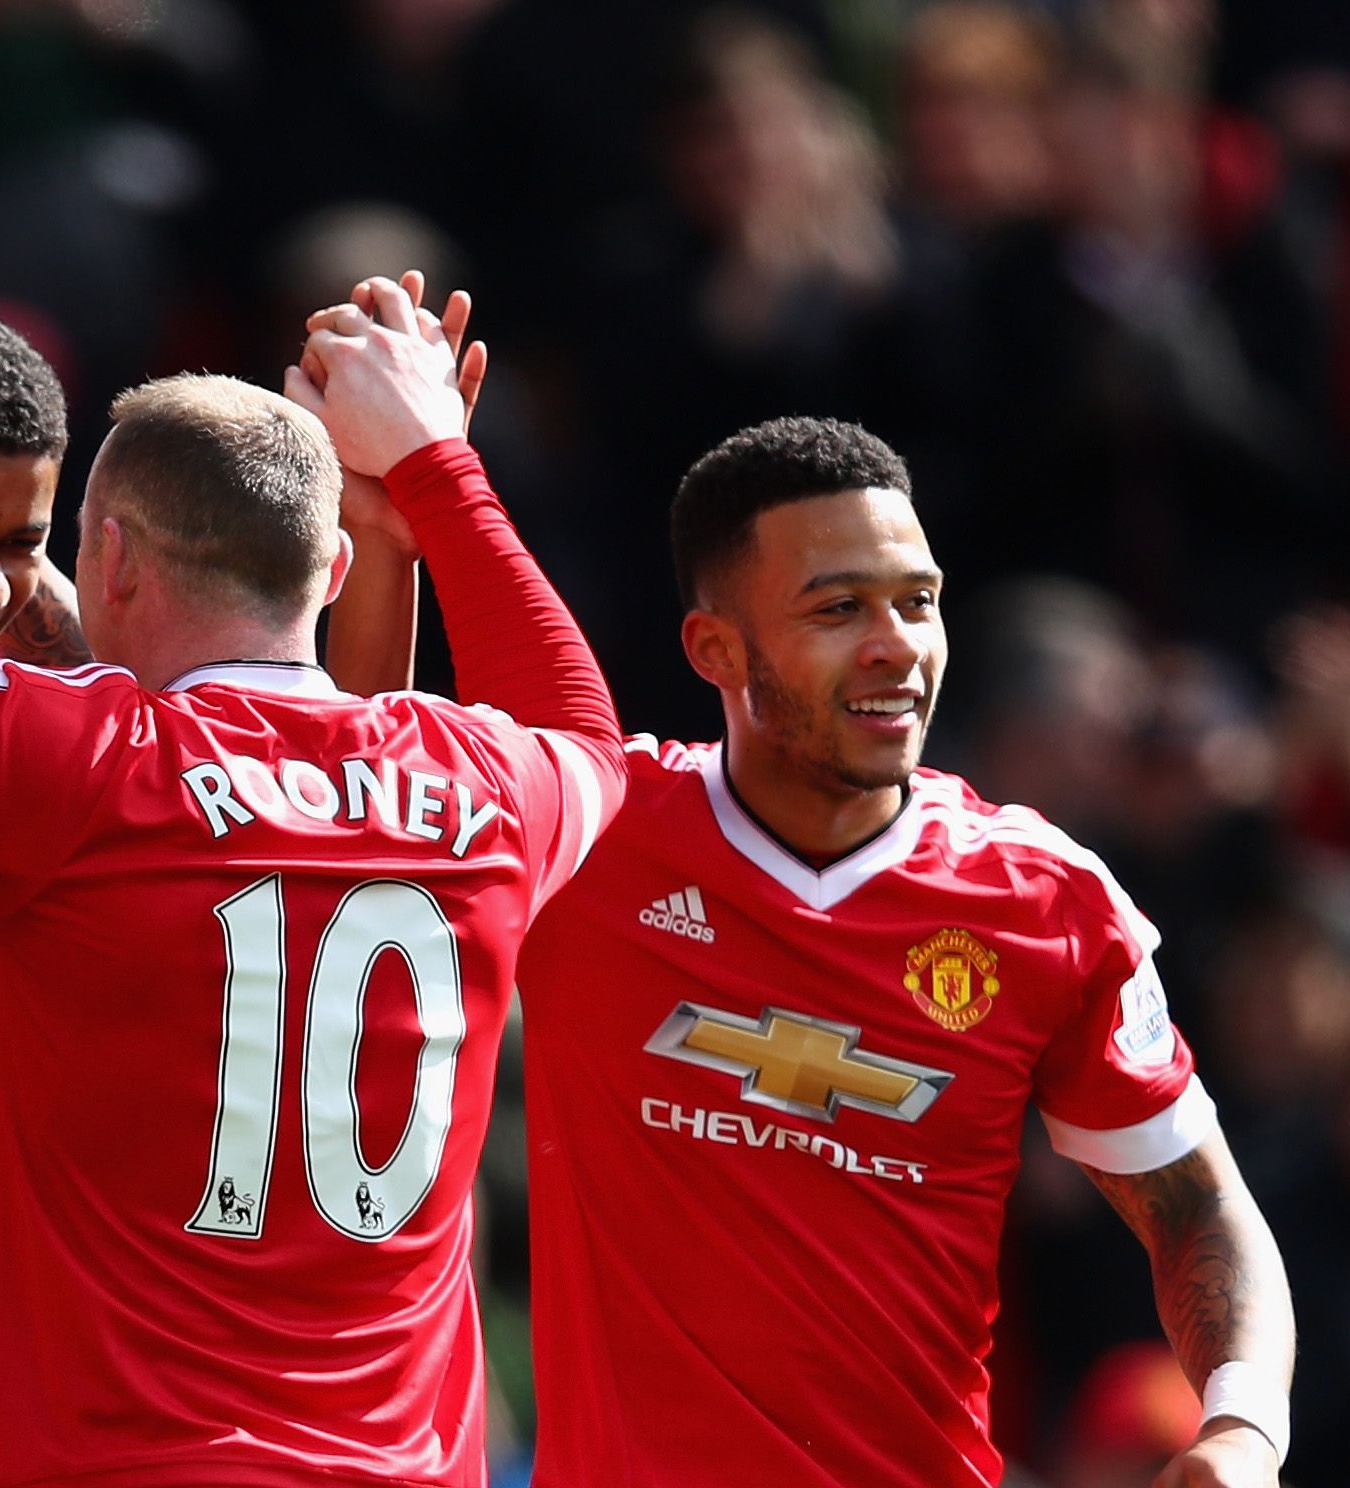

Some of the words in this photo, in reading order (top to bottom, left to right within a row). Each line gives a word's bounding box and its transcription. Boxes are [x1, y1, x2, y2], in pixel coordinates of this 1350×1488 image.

[181, 754, 501, 859] ROONEY
[639, 908, 715, 944] adidas
[183, 871, 467, 1244] 10
[928, 1005, 979, 1025] UNITED
[641, 1096, 928, 1184] CHEVROLET
